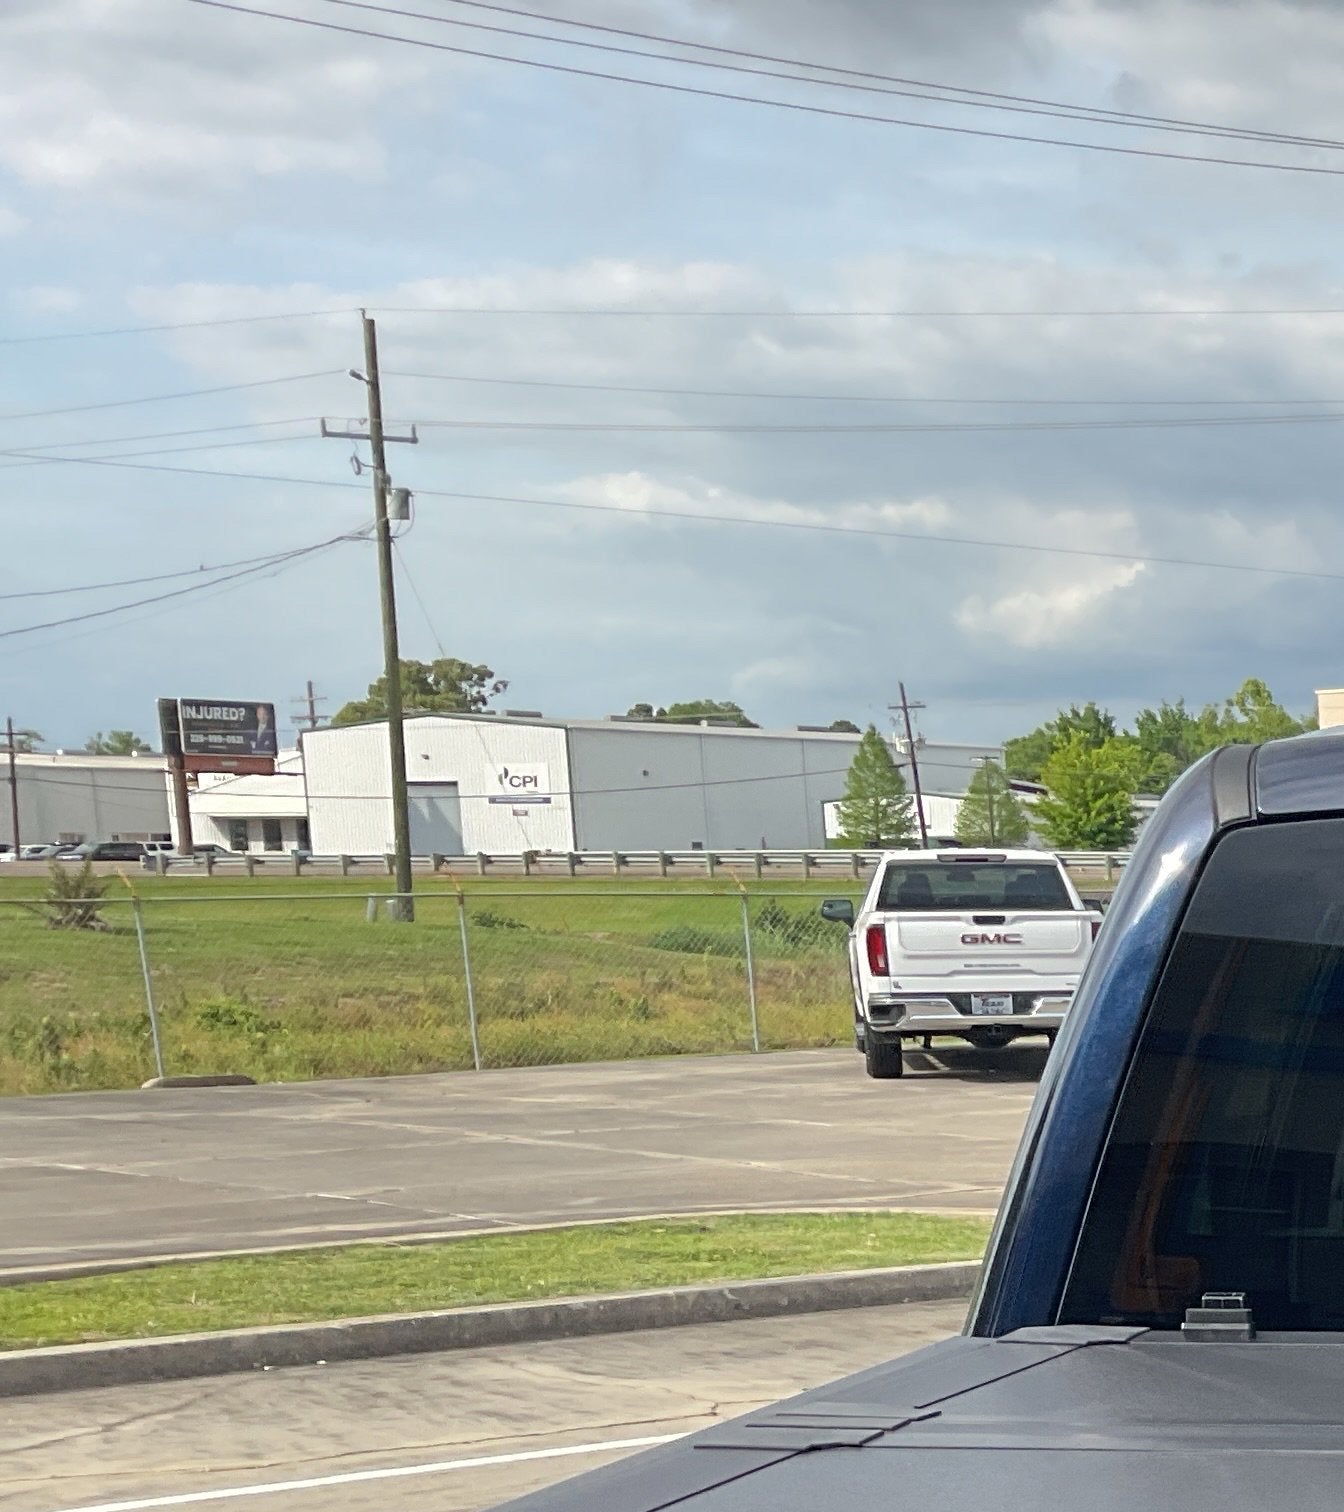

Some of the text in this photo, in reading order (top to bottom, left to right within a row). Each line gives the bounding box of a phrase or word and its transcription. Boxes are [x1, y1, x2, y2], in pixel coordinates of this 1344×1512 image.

[182, 704, 246, 721] INJURED?
[508, 775, 538, 788] CPI
[960, 933, 1023, 944] GMC
